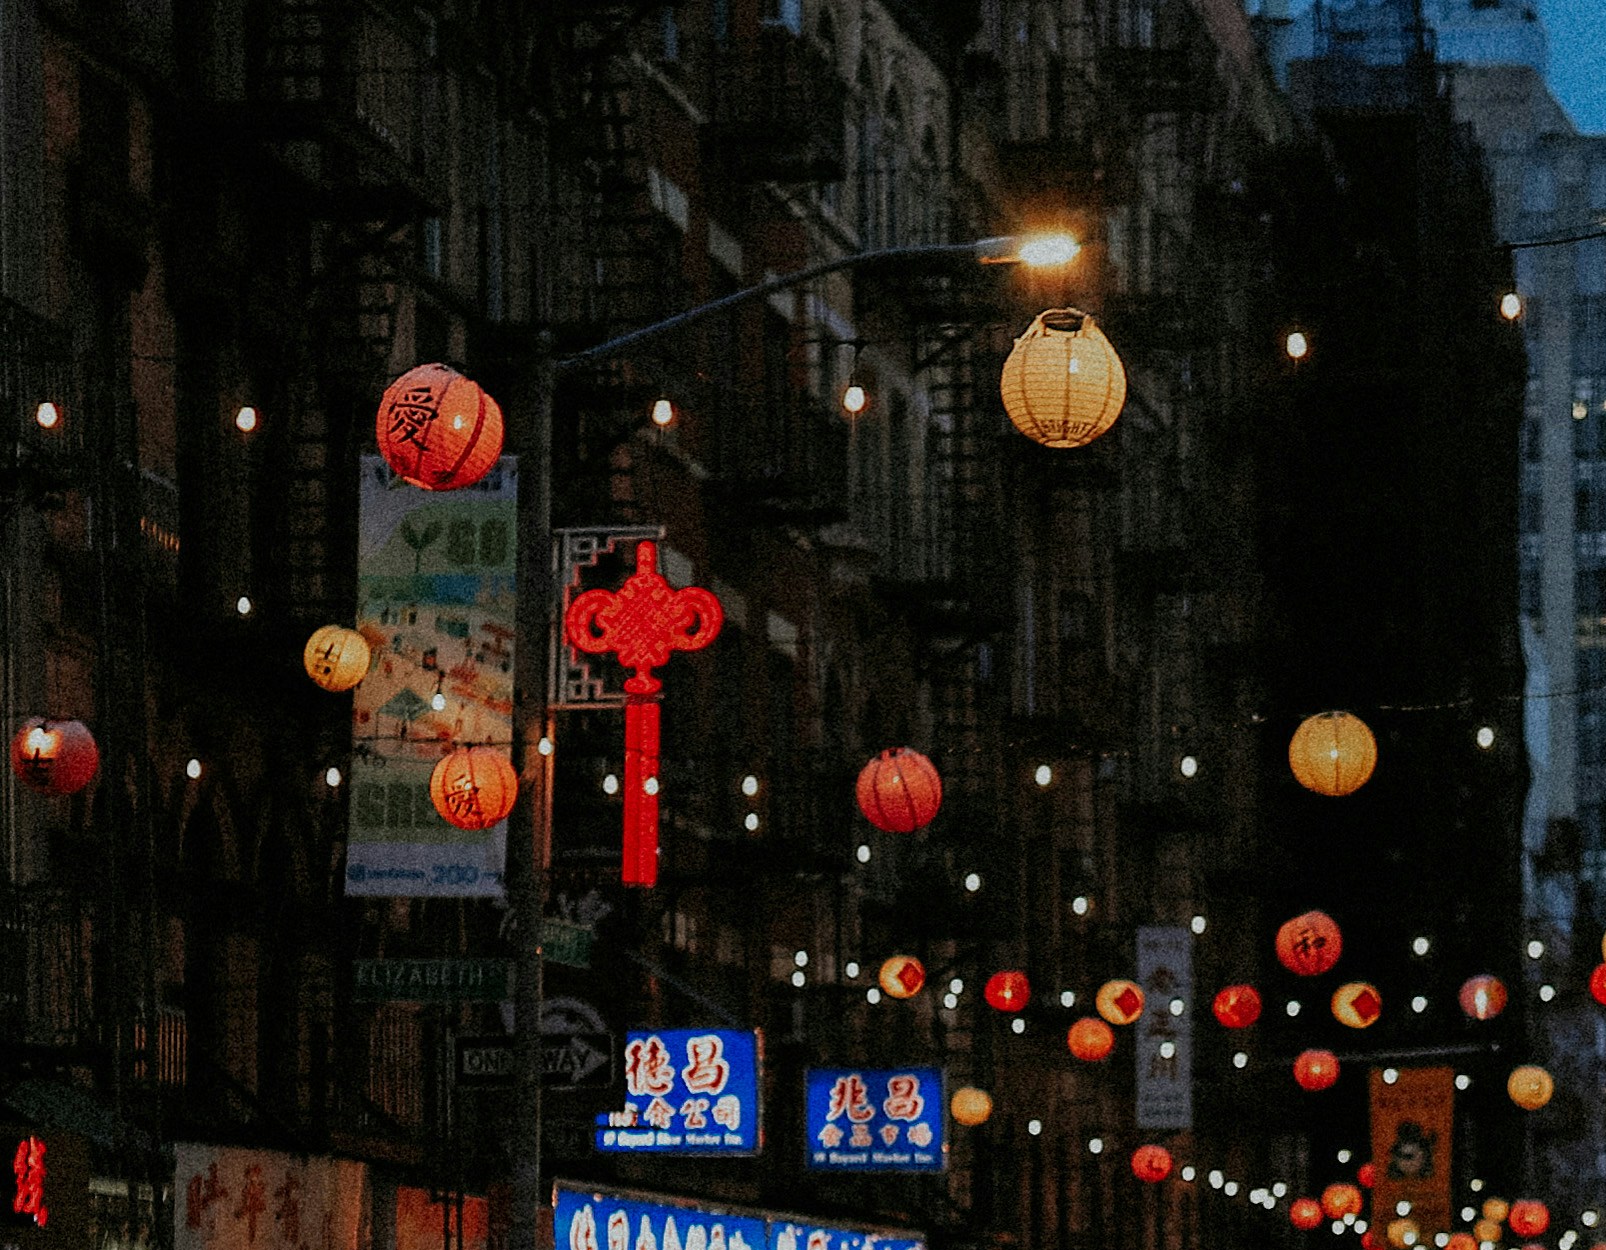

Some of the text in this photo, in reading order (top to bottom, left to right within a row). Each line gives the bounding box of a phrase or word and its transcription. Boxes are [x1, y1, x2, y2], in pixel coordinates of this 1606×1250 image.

[389, 387, 438, 452] 愛
[356, 965, 484, 986] ELIZABETH
[541, 1047, 591, 1074] WAY
[625, 1034, 730, 1096] 德昌
